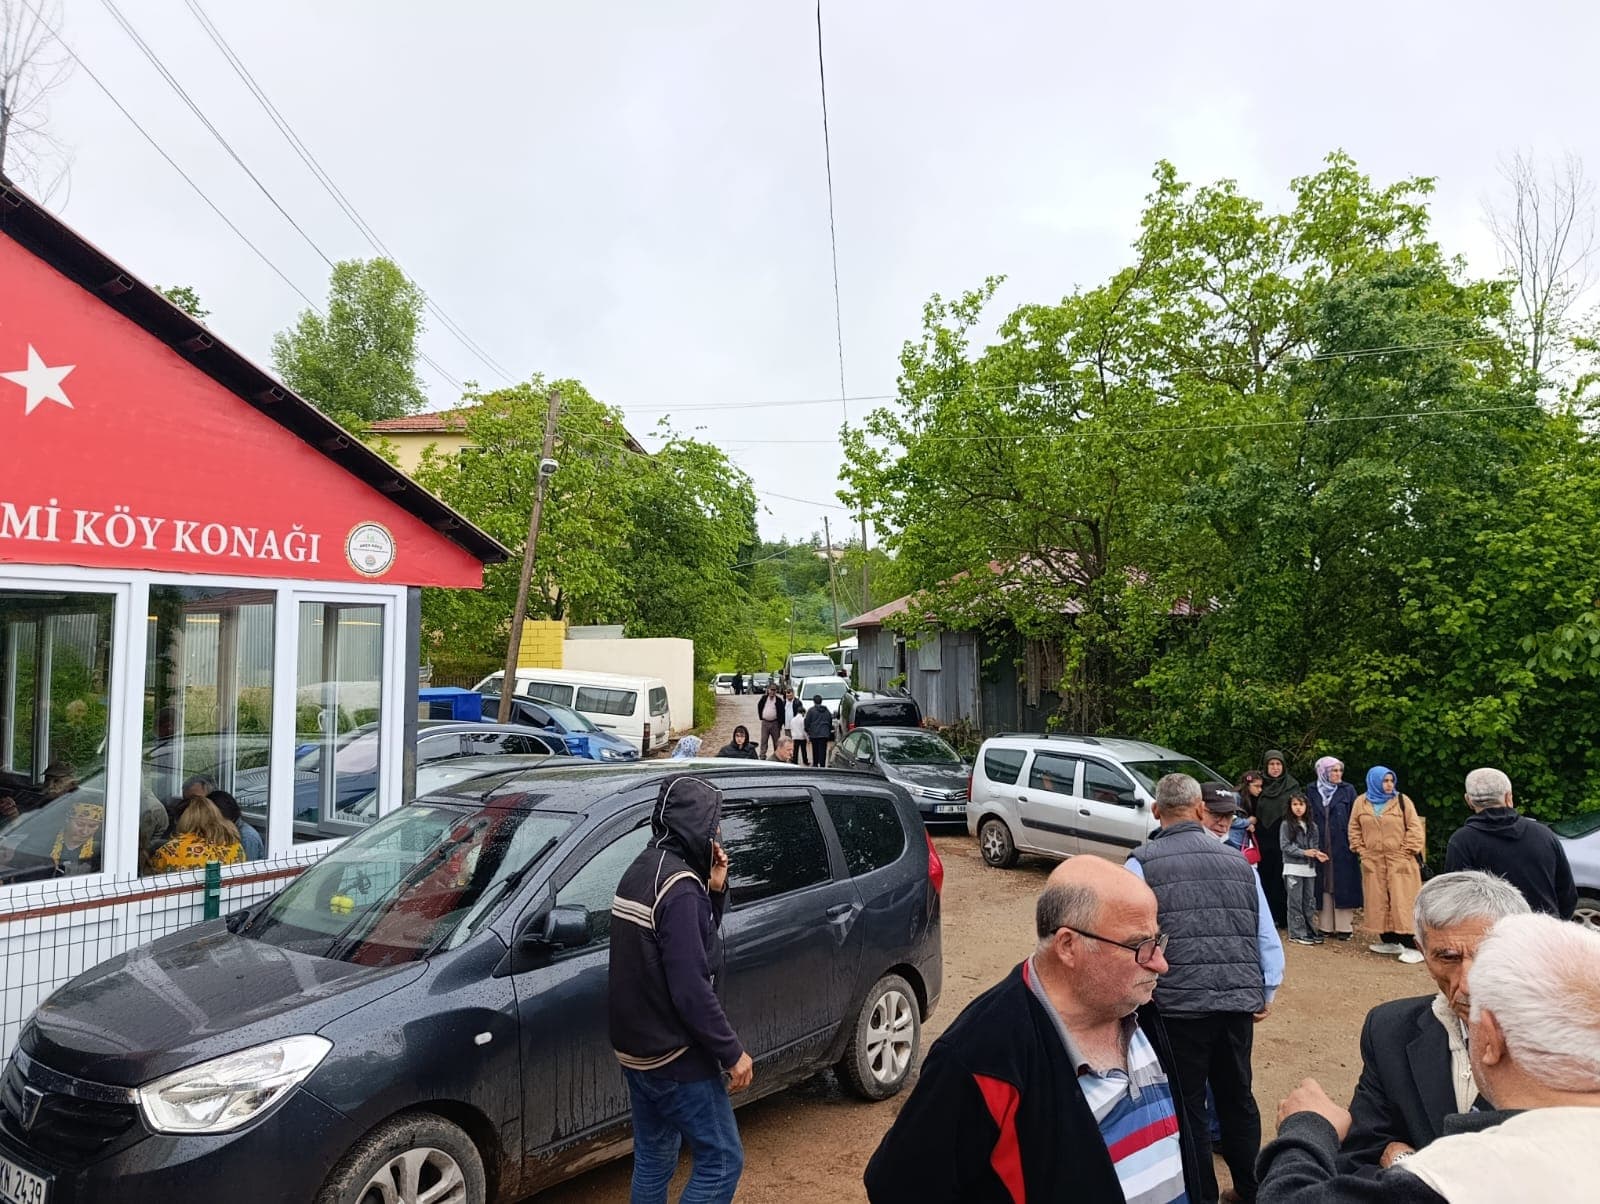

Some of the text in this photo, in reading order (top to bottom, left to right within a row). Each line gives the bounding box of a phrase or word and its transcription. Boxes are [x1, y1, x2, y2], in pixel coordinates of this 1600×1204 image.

[71, 505, 165, 550] KÖY
[171, 521, 321, 563] KONAĞI
[14, 1170, 42, 1204] 2439
